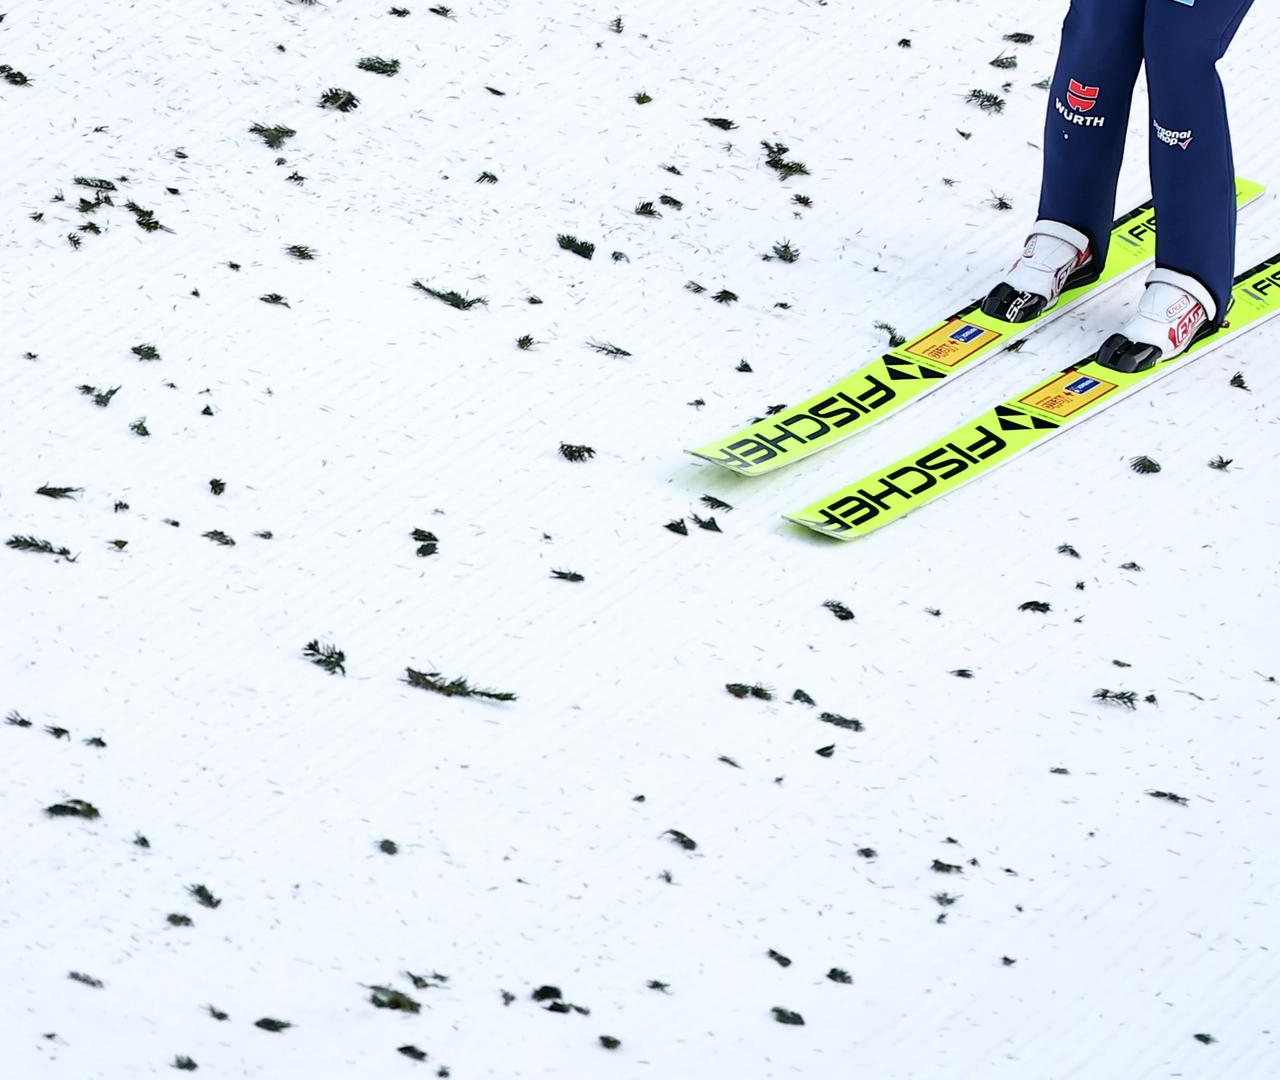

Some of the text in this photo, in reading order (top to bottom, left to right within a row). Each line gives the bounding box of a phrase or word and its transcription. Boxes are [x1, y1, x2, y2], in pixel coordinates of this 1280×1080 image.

[1055, 97, 1105, 127] WÜRTH
[719, 374, 896, 469] FISCHER
[817, 425, 1007, 533] FISCHER
